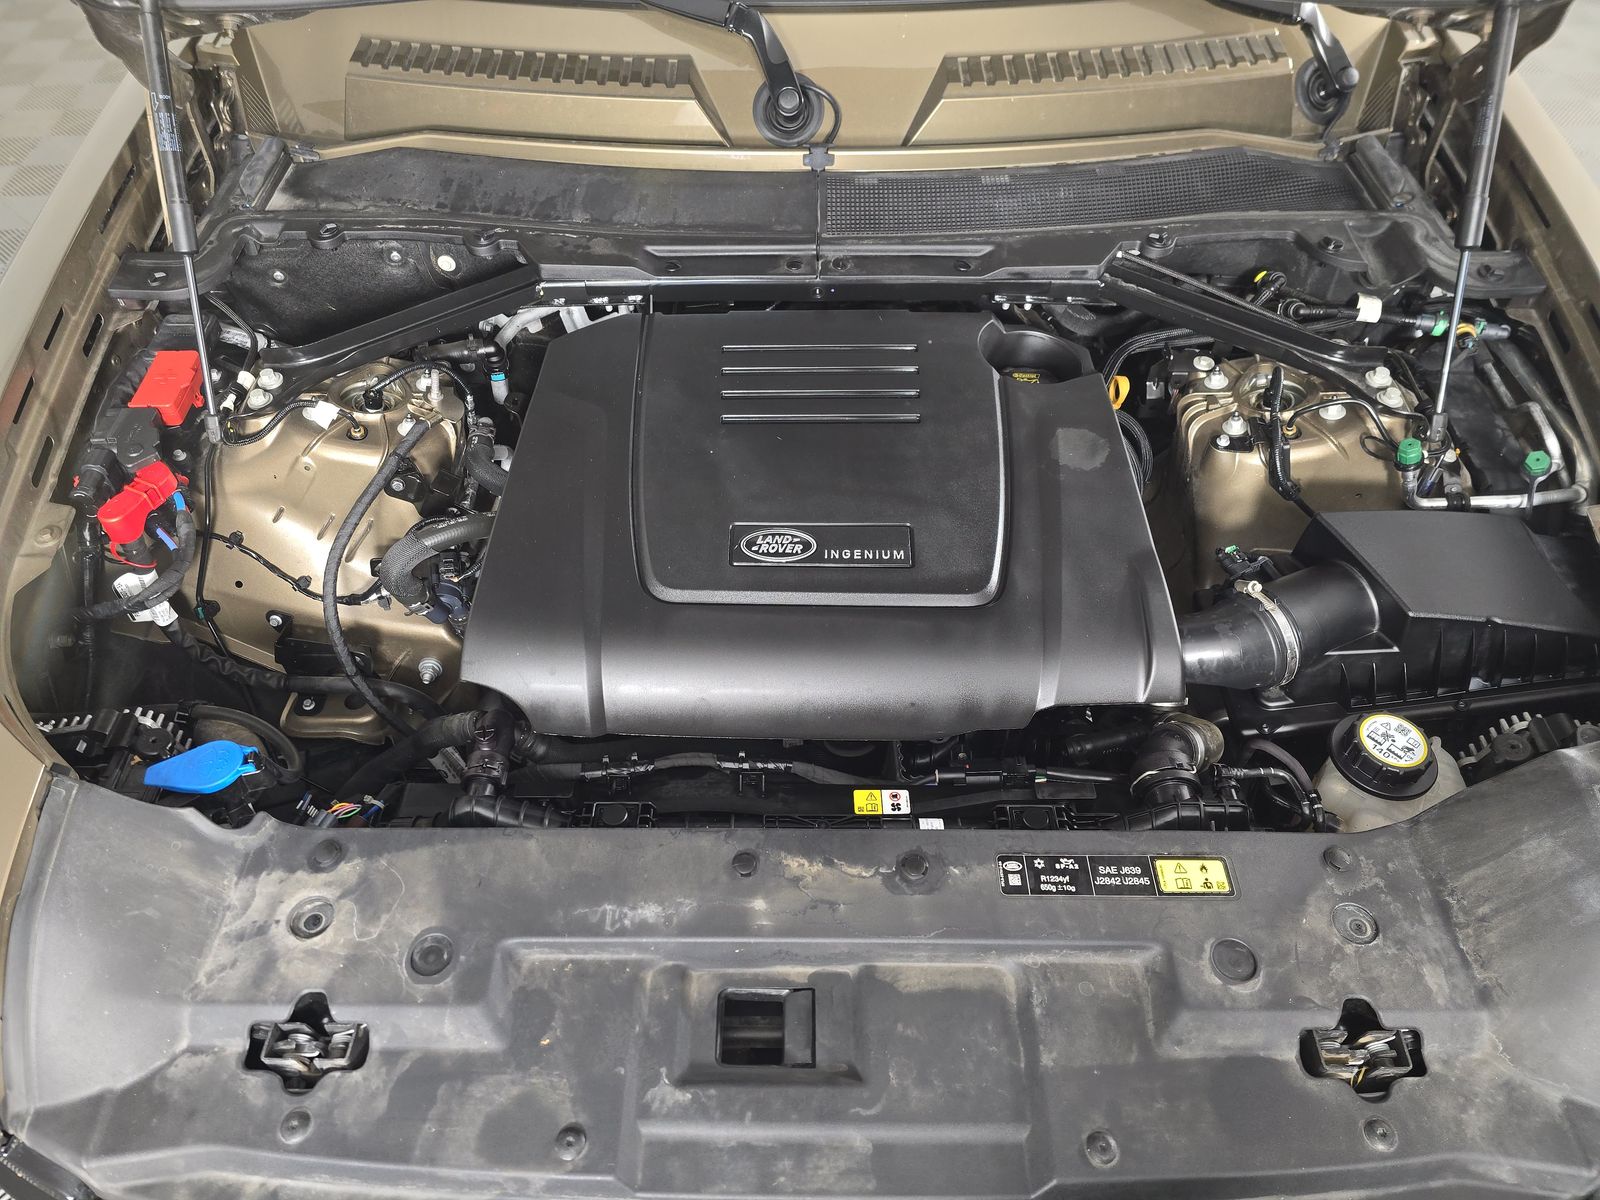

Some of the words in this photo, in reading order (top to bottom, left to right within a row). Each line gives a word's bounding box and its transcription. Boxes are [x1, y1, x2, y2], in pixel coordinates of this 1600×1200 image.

[756, 535, 793, 544] LAND
[758, 543, 804, 554] ROVER
[824, 549, 905, 560] INGENIUM
[1372, 744, 1390, 758] 140
[1098, 865, 1119, 875] SAE
[1119, 866, 1142, 875] J639
[1040, 874, 1070, 884] R1234yf
[1094, 876, 1122, 886] J2842
